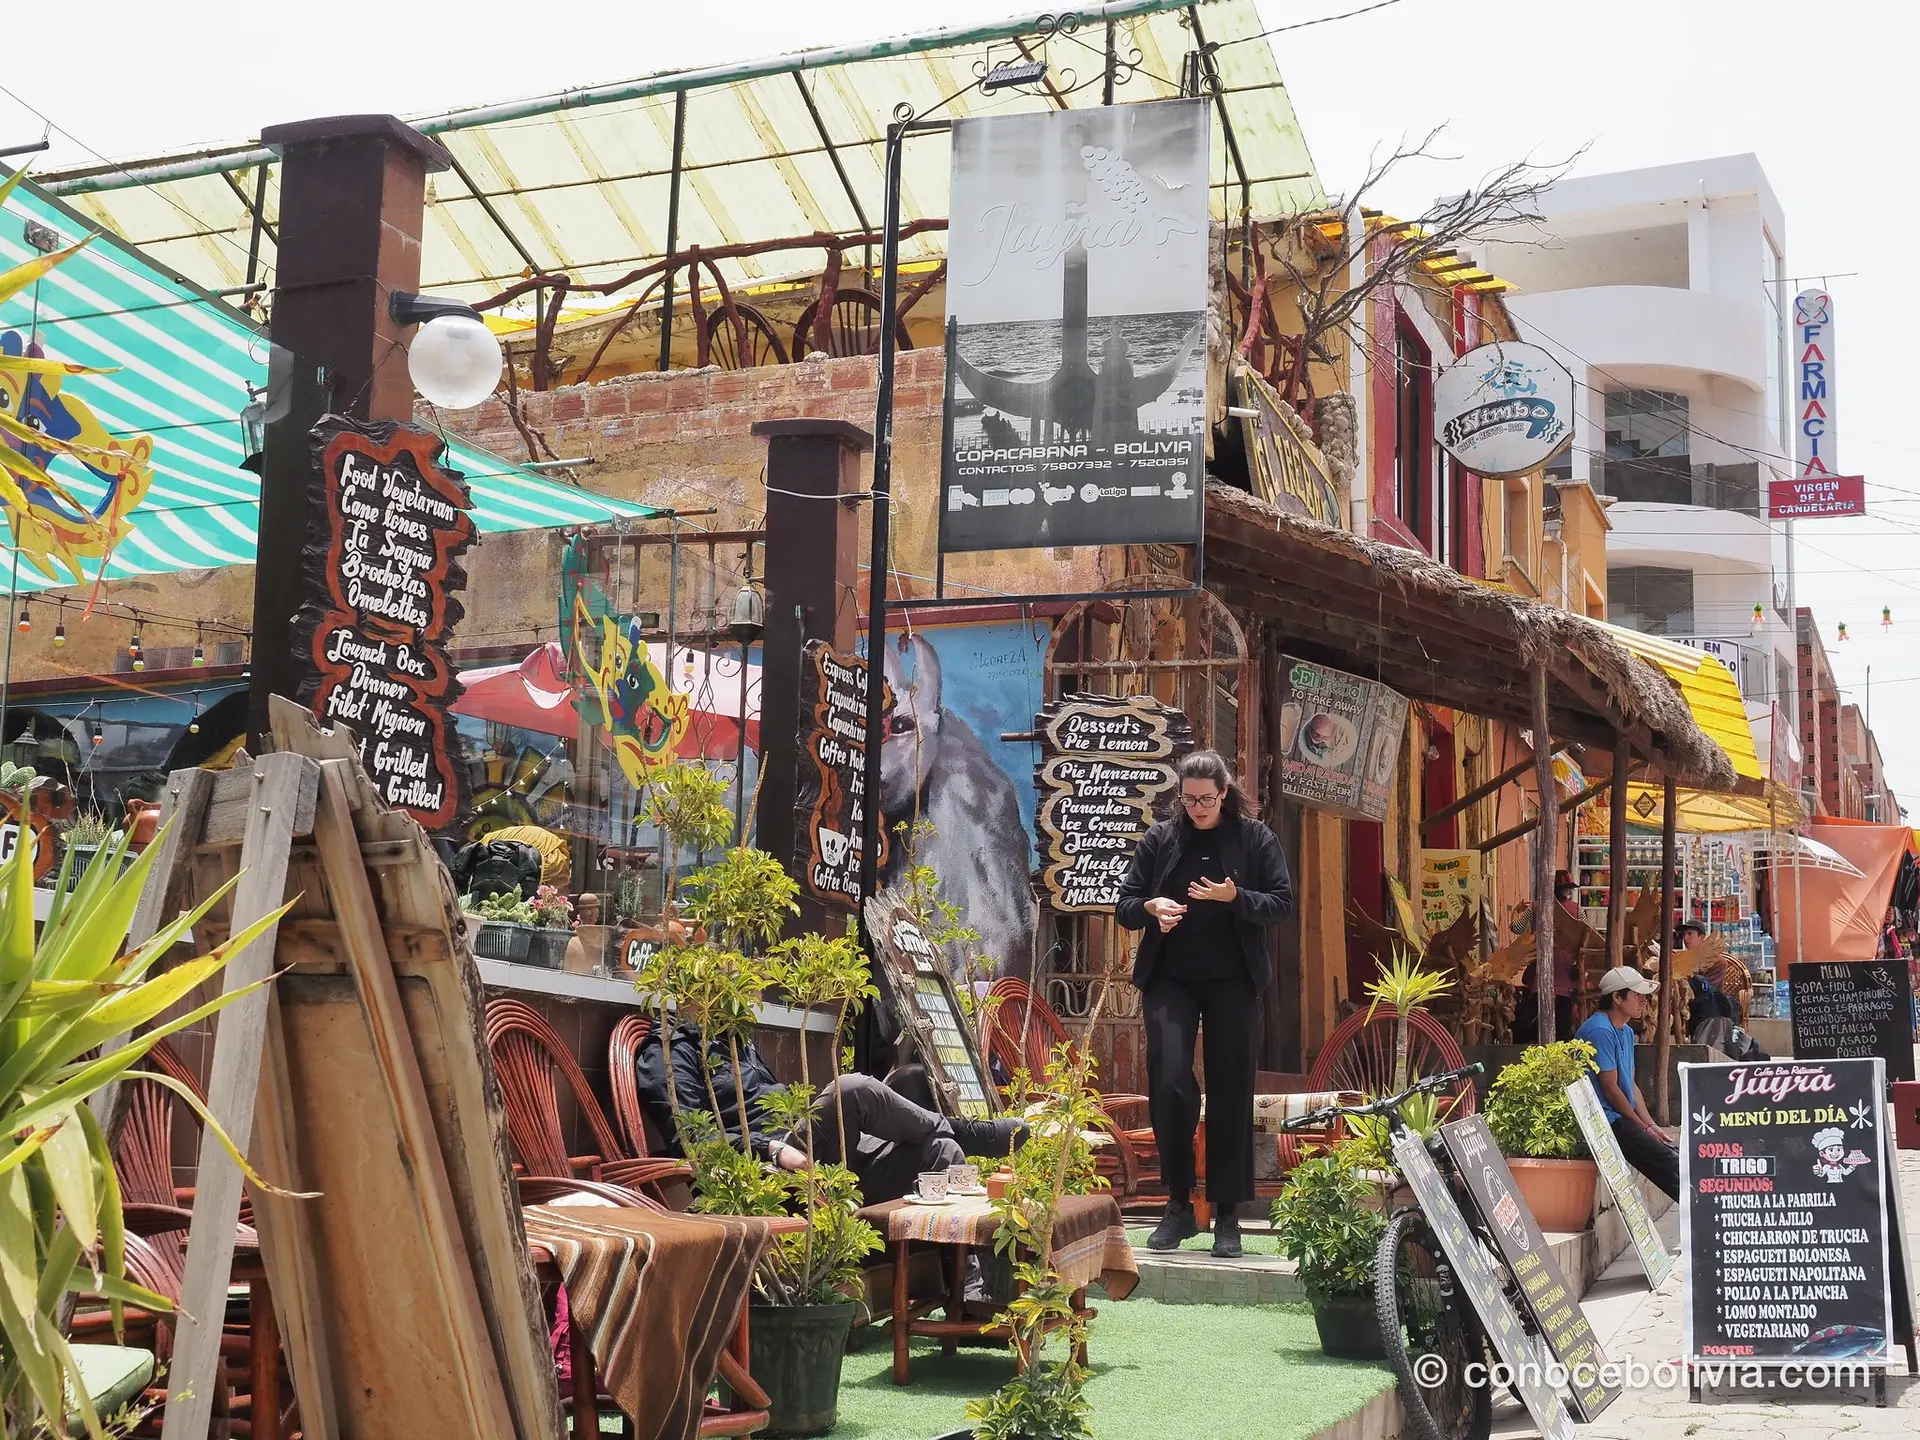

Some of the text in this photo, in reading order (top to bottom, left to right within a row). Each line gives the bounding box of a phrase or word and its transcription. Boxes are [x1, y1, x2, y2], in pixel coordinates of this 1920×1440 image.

[1801, 325, 1827, 476] FARMACIA
[955, 445, 1087, 462] COPACABANA
[1114, 440, 1192, 455] BOLIVIA
[340, 454, 378, 491] Food
[958, 464, 1037, 476] CONTACTOS:
[1042, 460, 1112, 472] 75807332
[1130, 457, 1189, 467] 75201351
[1100, 487, 1127, 497] LaLiga
[1794, 481, 1839, 493] VIRGEN
[342, 485, 379, 523] Cane
[1800, 492, 1835, 503] DE LA
[1779, 501, 1855, 514] CANDELARIA
[345, 519, 370, 554] La
[341, 551, 427, 598] Brochetas
[348, 577, 427, 628] Omelettes
[1704, 641, 1721, 654] EN
[396, 644, 426, 676] Box
[823, 652, 854, 686] Express
[350, 661, 408, 700] Dinner
[1290, 688, 1363, 715] TO TAKE AWAY
[1068, 715, 1141, 735] Desserts
[819, 736, 847, 765] Coffee
[1064, 733, 1149, 752] Pie Lemon
[374, 741, 429, 779] Grilled
[1059, 762, 1159, 785] Pie Manzana
[387, 775, 442, 810] Grilled
[1075, 780, 1127, 798] Tortas
[1300, 776, 1327, 790] FAST
[1330, 784, 1351, 797] FOR
[1059, 797, 1131, 816] Pancakes
[1060, 815, 1138, 832] Ice Cream
[1064, 832, 1127, 855] Juices
[847, 850, 860, 874] Ice
[1075, 854, 1130, 876] Musly
[814, 863, 840, 893] Coffee
[1062, 870, 1108, 888] Fruit
[628, 939, 655, 972] Coff
[1872, 966, 1889, 982] 25
[1833, 987, 1892, 1003] CHAMPIÑONES
[1852, 1012, 1891, 1021] TRUCHA
[1831, 1022, 1876, 1034] PLANCHA
[1799, 1035, 1877, 1048] LOMITO ASADO
[1837, 1045, 1874, 1058] POSTRE
[1725, 1067, 1836, 1105] Juyra
[1719, 1104, 1849, 1127] MENÚ DEL DÍA
[1698, 1143, 1744, 1158] SOPAS:
[1720, 1158, 1769, 1175] TRIGO
[1699, 1177, 1774, 1193] SEGUNDOS:
[1721, 1192, 1836, 1209] TRUCHA A LA PARRILLA
[1721, 1211, 1813, 1227] TRUCHA AL AJILLO
[1723, 1228, 1869, 1246] CHICHARRON DE TRUCHA
[1723, 1248, 1851, 1264] ESPAGUETI BOLONESA
[1724, 1266, 1866, 1282] ESPAGUETI NAPOLITANA
[1724, 1285, 1848, 1301] POLLO A LA PLANCHA
[1725, 1304, 1817, 1320] LOMO MONTADO
[1725, 1323, 1809, 1339] VEGETARIANO
[1702, 1345, 1754, 1356] POSTRE
